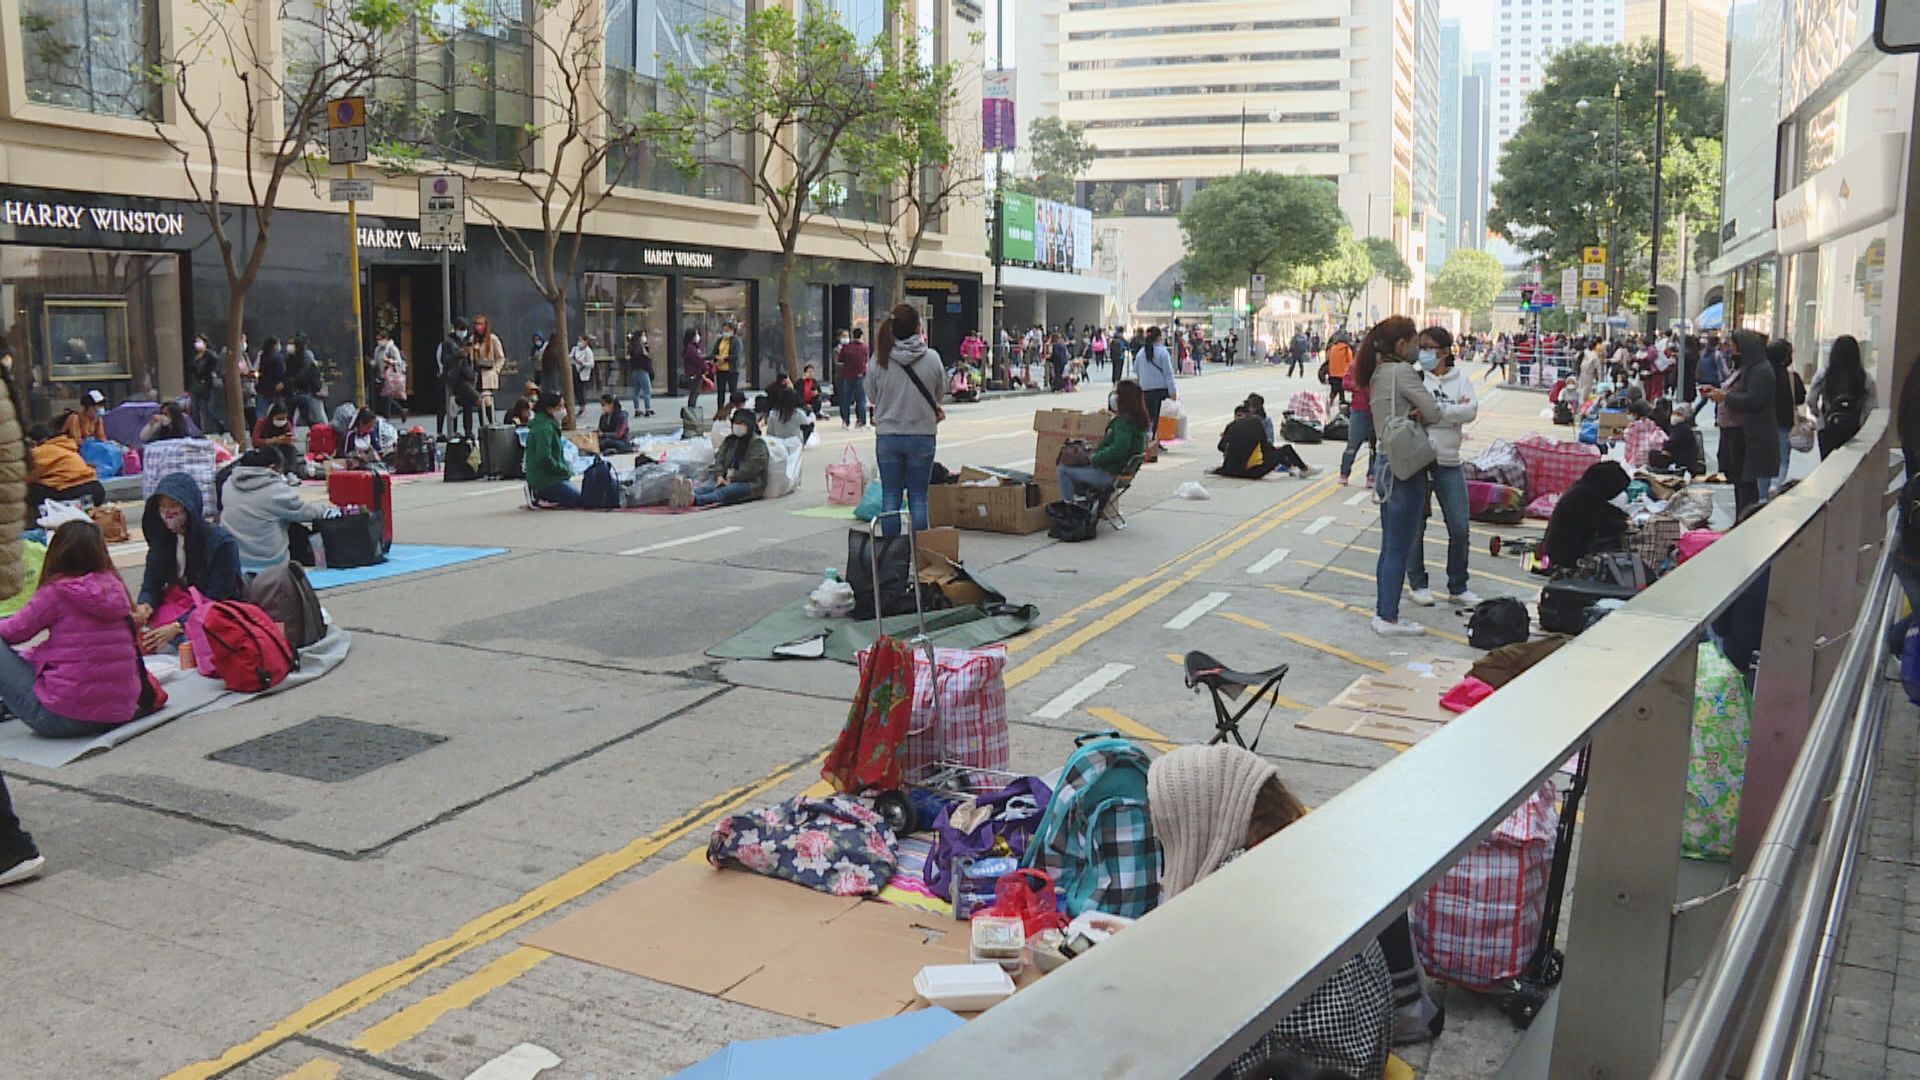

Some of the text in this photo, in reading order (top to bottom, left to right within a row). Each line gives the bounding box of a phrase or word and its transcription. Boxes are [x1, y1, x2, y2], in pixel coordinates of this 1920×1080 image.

[351, 129, 358, 142] 7
[352, 146, 359, 158] 7
[5, 200, 183, 235] HARRY WINSTON
[356, 227, 404, 249] HARRY
[448, 232, 461, 243] 12
[644, 248, 713, 268] HARRY WINSTON
